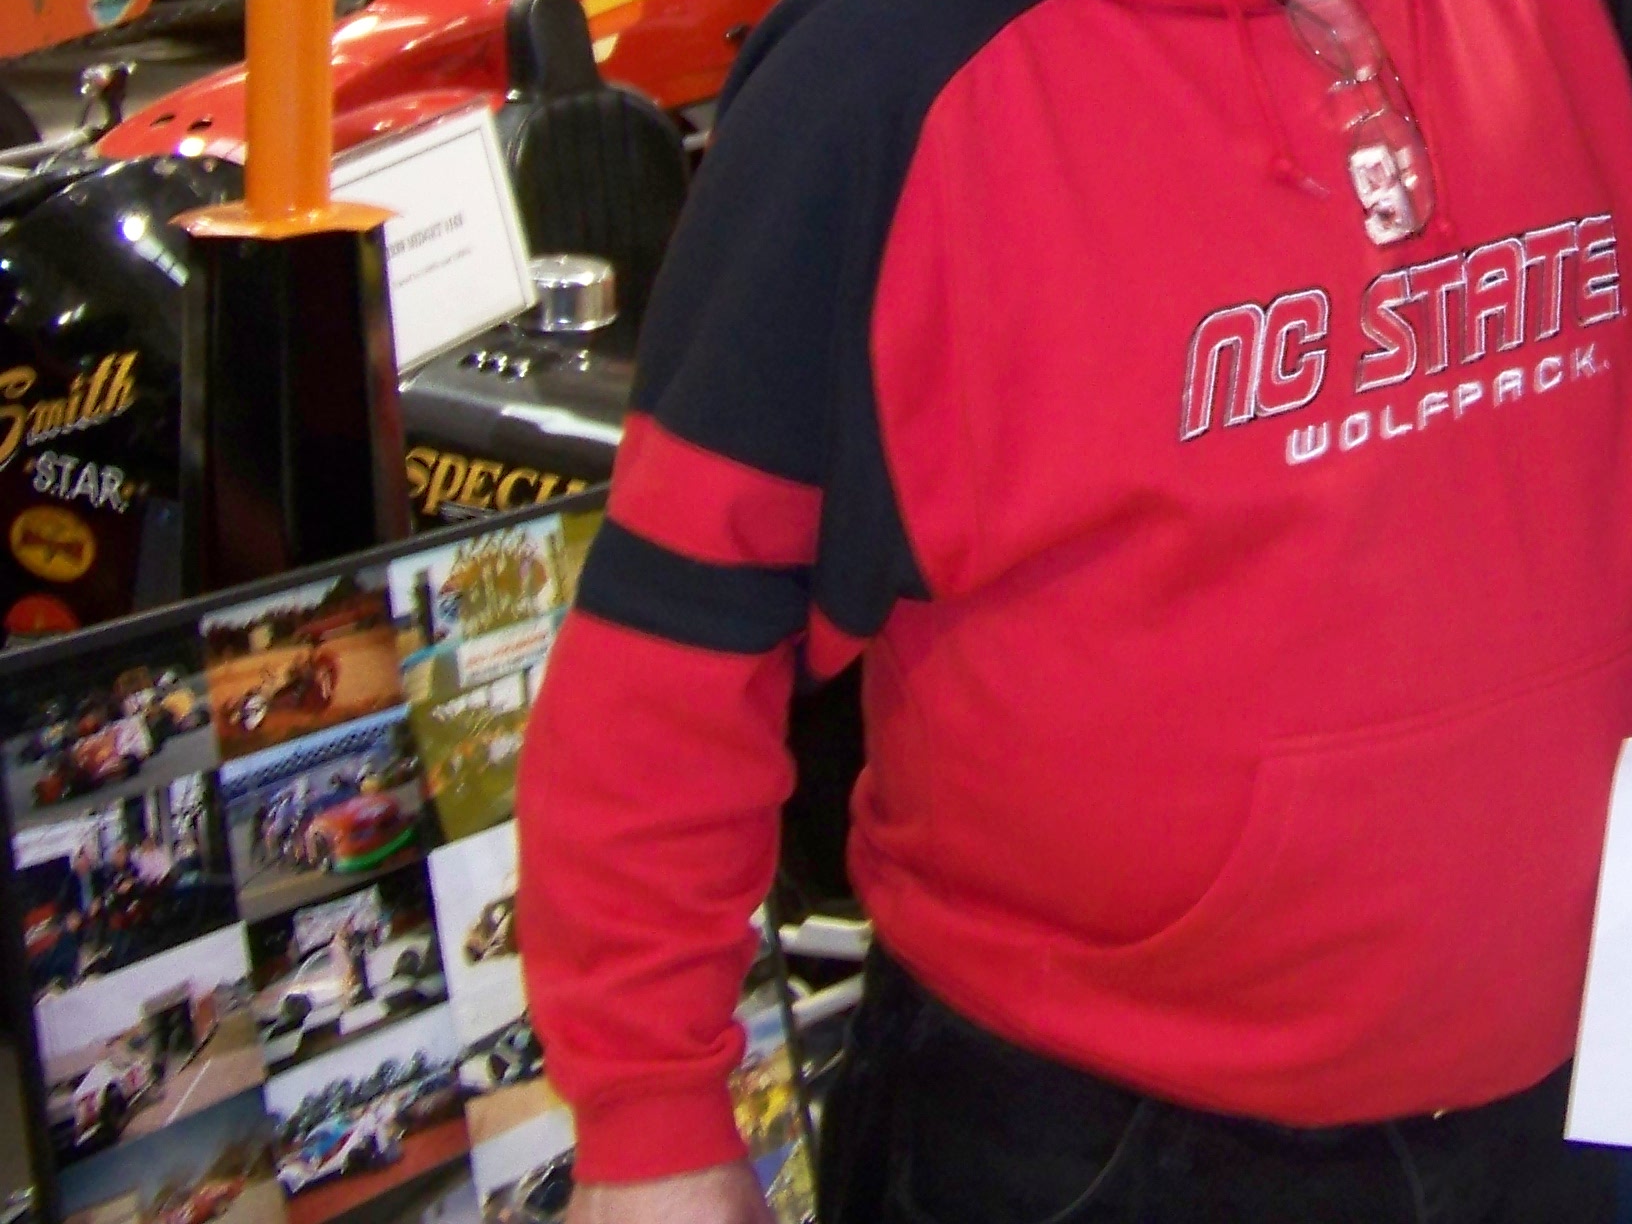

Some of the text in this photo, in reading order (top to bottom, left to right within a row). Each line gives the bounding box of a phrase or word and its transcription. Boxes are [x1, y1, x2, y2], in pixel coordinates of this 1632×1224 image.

[1179, 213, 1623, 443] NC STATE
[1284, 342, 1603, 466] WOLFPACK
[32, 450, 130, 515] STAR
